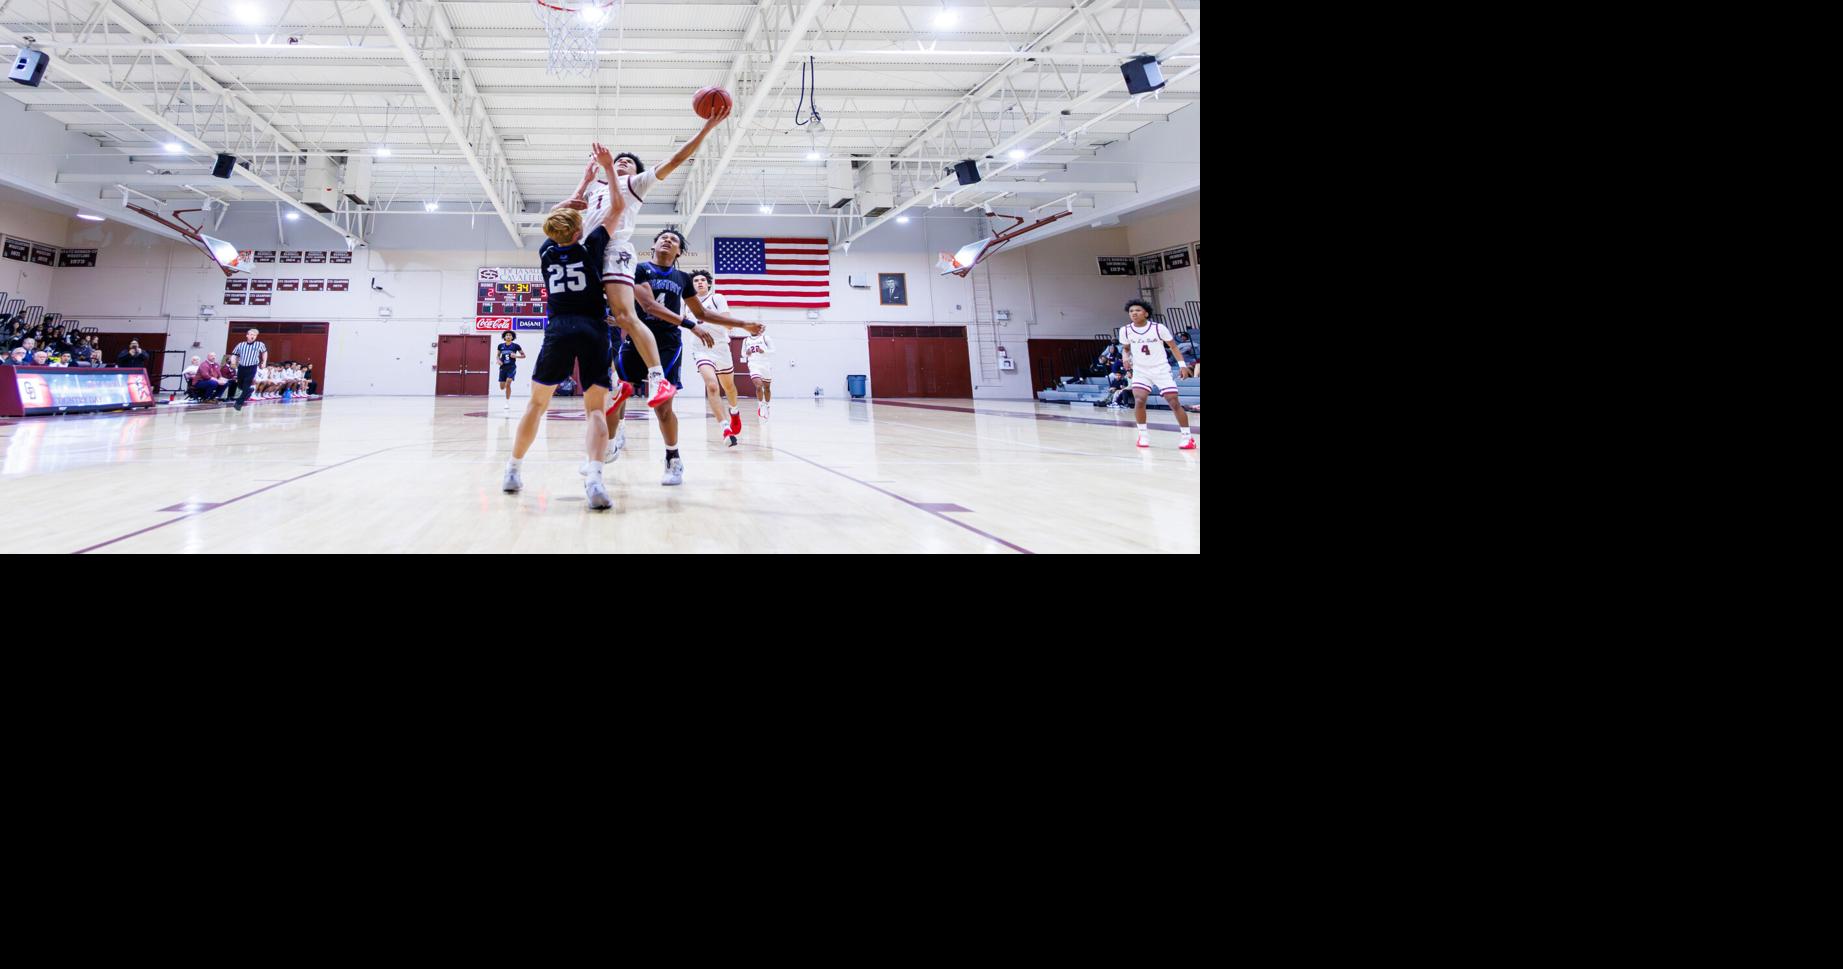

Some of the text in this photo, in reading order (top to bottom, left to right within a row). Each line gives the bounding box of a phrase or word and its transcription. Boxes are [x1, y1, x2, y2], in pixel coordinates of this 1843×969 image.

[547, 262, 587, 294] 25
[488, 288, 495, 297] 2
[504, 283, 529, 292] 4:34
[541, 288, 548, 298] 5
[477, 318, 511, 330] Coca-Cola
[1141, 345, 1150, 355] 4
